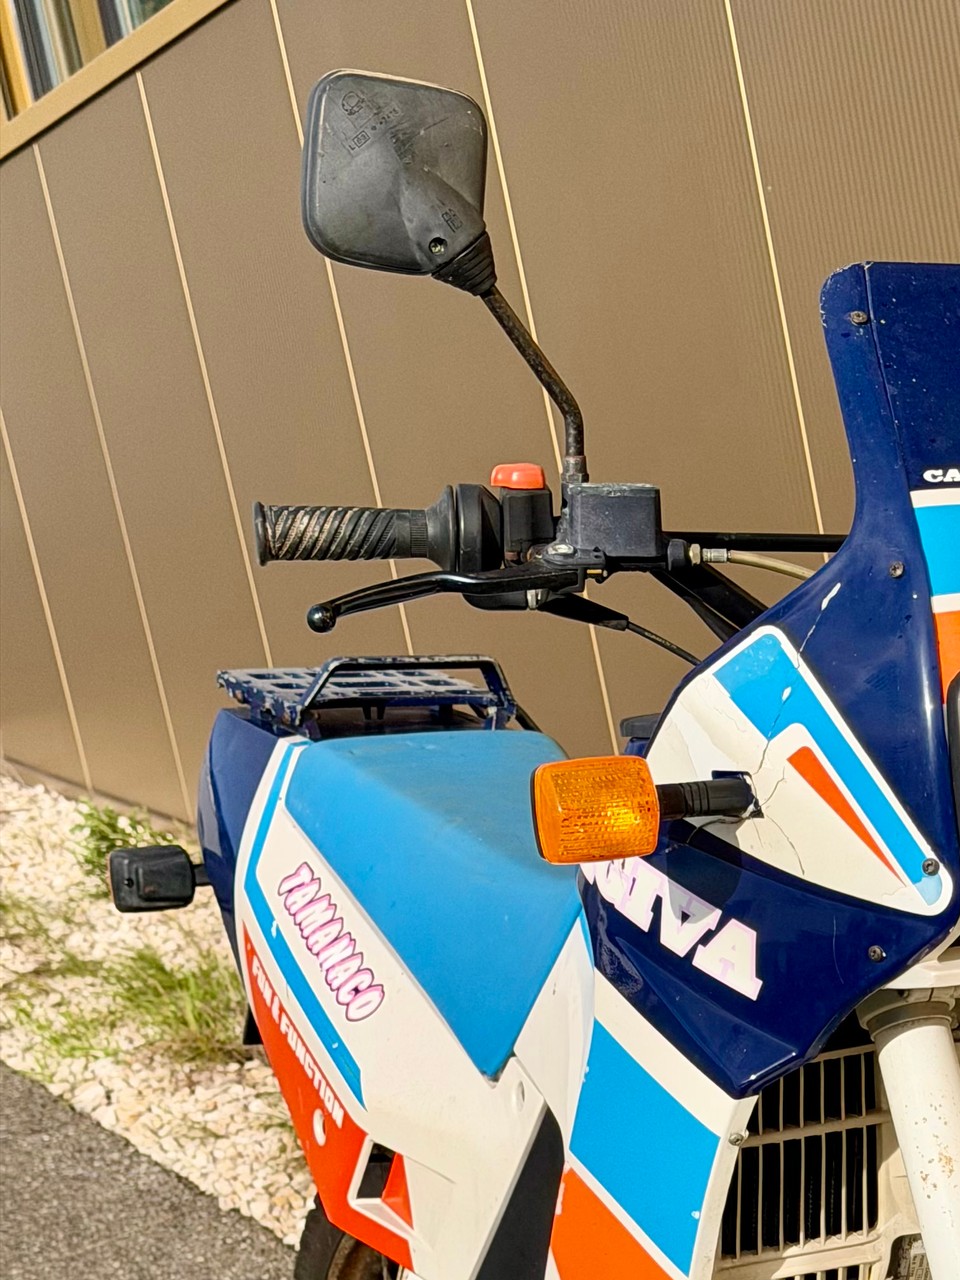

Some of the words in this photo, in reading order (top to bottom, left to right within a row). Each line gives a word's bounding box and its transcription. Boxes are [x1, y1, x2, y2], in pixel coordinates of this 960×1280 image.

[278, 862, 385, 1022] TAMANACO
[580, 856, 763, 1001] GIVA
[252, 955, 273, 1007] FUN
[280, 1012, 345, 1129] FUNCTION
